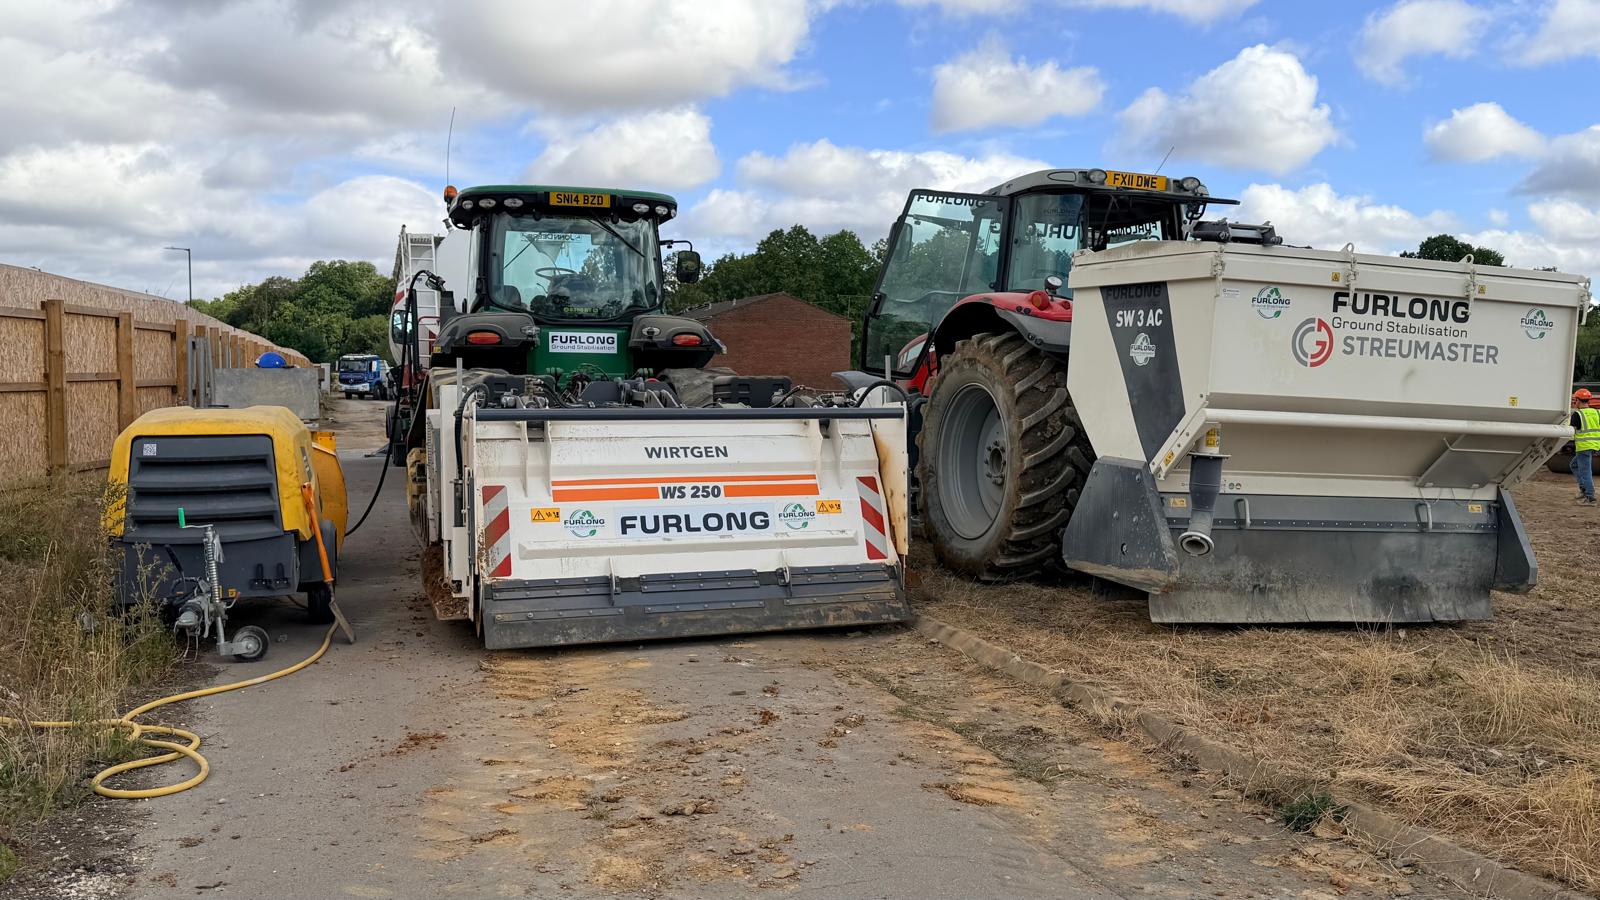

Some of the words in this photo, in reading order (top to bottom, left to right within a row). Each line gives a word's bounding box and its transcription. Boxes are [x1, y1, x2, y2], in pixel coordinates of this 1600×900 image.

[1113, 173, 1134, 186] FX11
[1136, 175, 1158, 189] DWE
[556, 193, 580, 205] SN14
[583, 194, 604, 206] BZD
[1105, 284, 1162, 300] FURLONG
[1251, 297, 1291, 305] FURLONG
[1332, 292, 1470, 324] FURLONG
[1115, 309, 1136, 328] SW
[1137, 309, 1145, 327] 3
[1146, 308, 1163, 327] AC
[1521, 317, 1554, 328] FURLONG
[1331, 316, 1383, 332] Ground
[1386, 321, 1469, 339] Stabilisation
[551, 335, 616, 345] FURLONG
[1131, 344, 1157, 352] FURLONG
[1342, 335, 1499, 365] STREUMASTER
[644, 445, 729, 459] WIRTGEN
[661, 485, 687, 500] WS
[690, 484, 722, 499] 250
[563, 518, 605, 526] FURLONG
[778, 511, 815, 519] FURLONG
[620, 511, 770, 535] FURLONG
